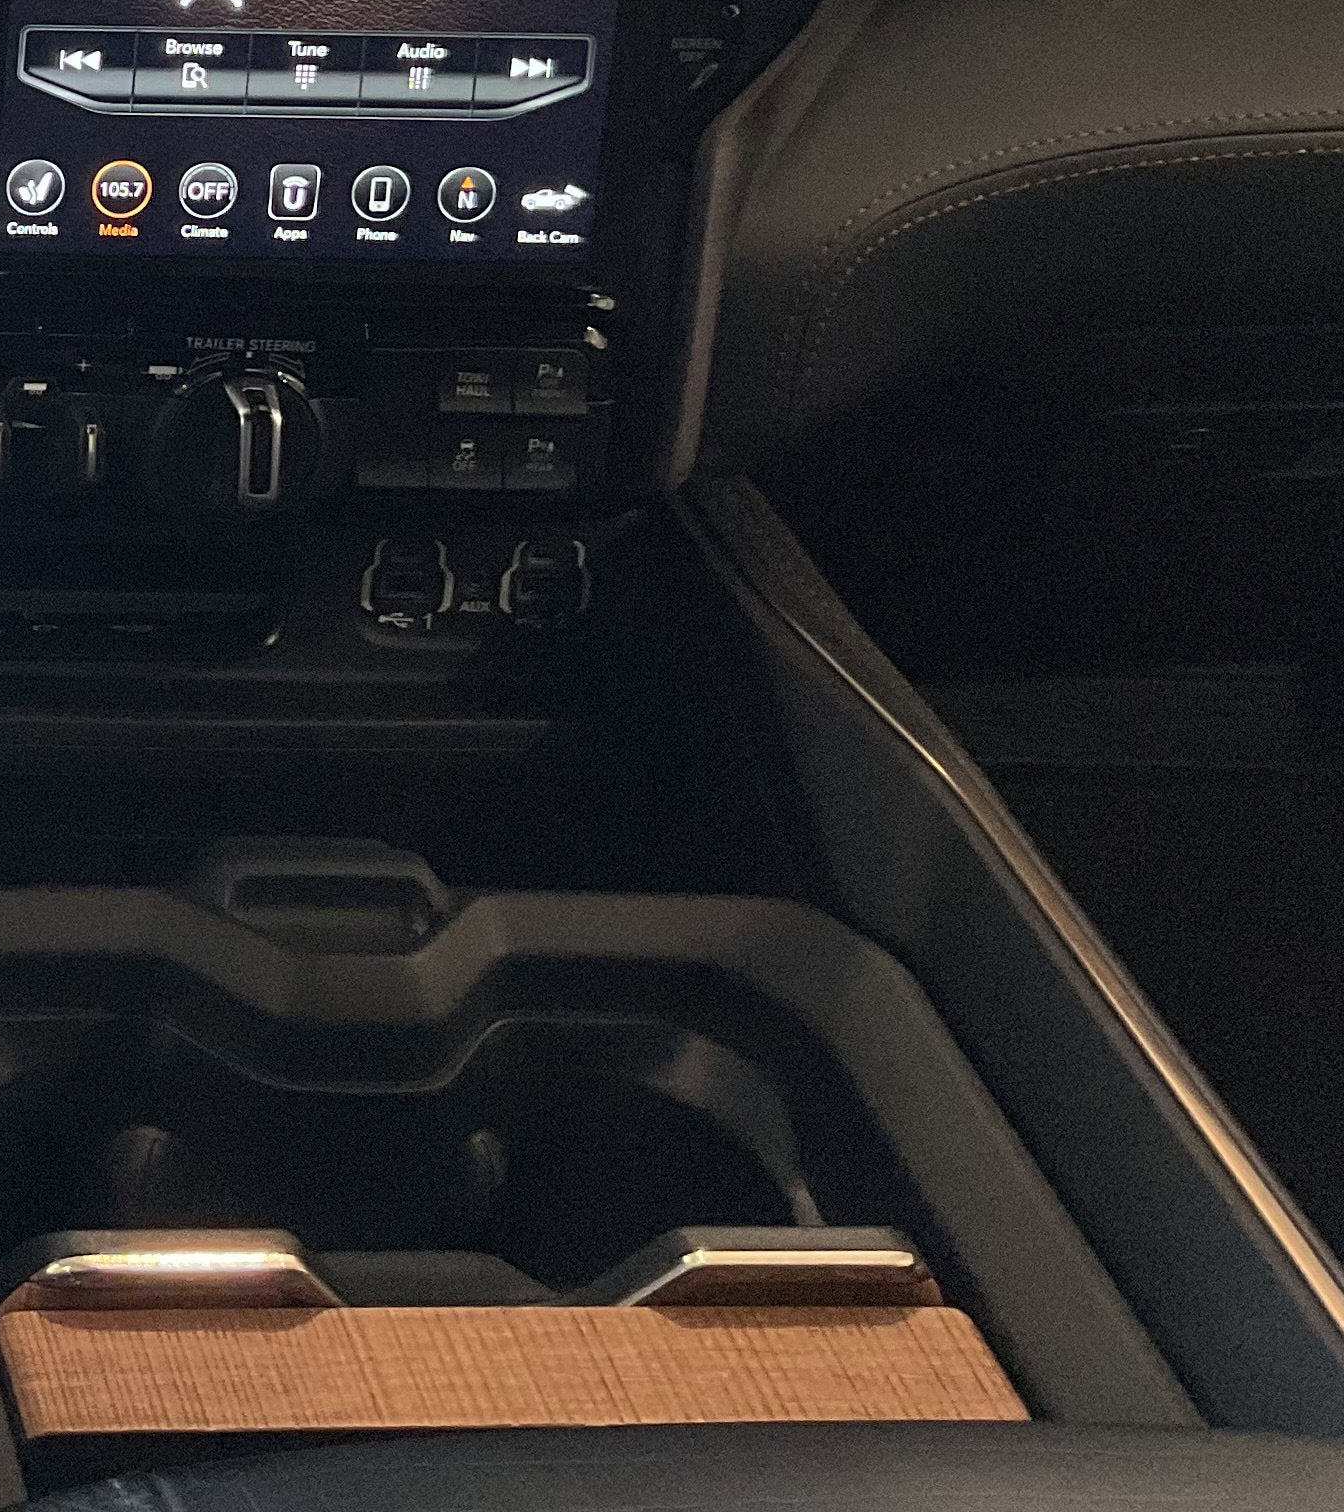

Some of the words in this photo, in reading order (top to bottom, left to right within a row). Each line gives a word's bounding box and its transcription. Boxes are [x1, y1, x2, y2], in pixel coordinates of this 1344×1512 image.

[165, 38, 223, 56] Browse
[288, 40, 329, 58] Tune
[397, 42, 447, 59] Audio
[99, 181, 144, 198] 105.7
[187, 182, 230, 200] OFF
[7, 221, 58, 236] Controls
[99, 223, 138, 237] Media
[180, 224, 229, 239] Climate
[273, 226, 308, 241] Apps
[356, 227, 397, 242] Phone
[450, 229, 477, 242] Nav
[517, 230, 547, 244] Back
[549, 231, 580, 244] Cam
[186, 336, 244, 350] TRAILER
[248, 339, 316, 352] STEERING
[459, 600, 491, 613] AUX
[421, 613, 434, 631] 1
